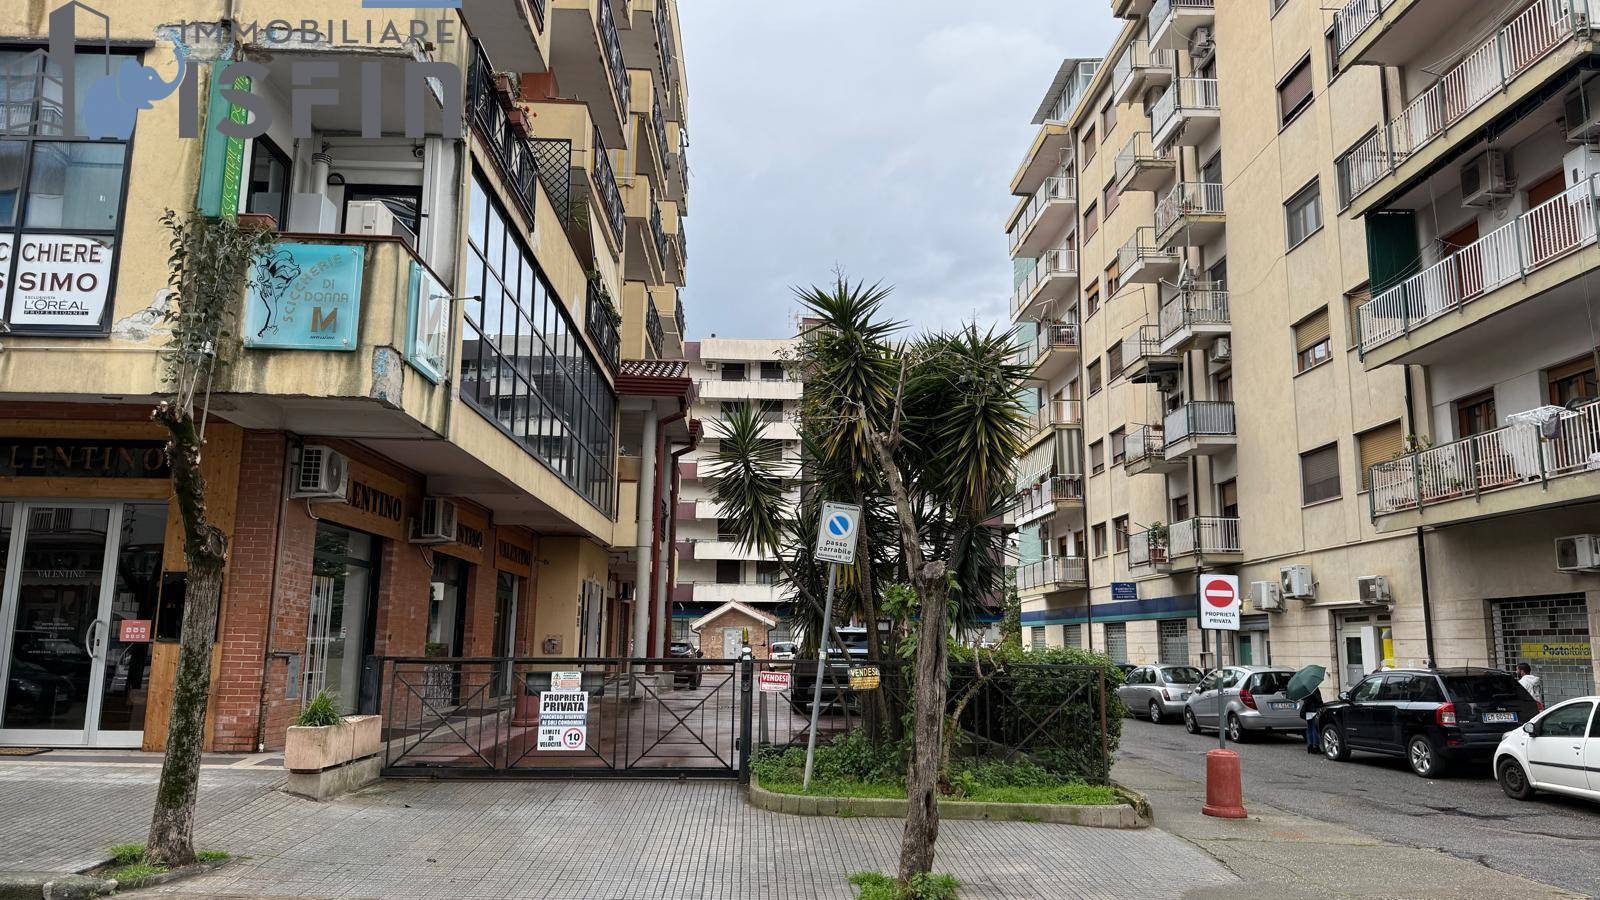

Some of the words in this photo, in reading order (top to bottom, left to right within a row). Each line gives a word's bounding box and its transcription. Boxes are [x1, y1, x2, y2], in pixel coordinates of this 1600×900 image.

[282, 253, 343, 323] SCICCHERIE
[322, 279, 335, 289] DI
[351, 480, 402, 522] ENTINO
[819, 546, 852, 555] carrabile
[762, 673, 788, 683] VENDESI
[544, 692, 585, 701] PROPRIETÀ
[543, 702, 585, 711] PRIVATA
[567, 733, 580, 741] 10
